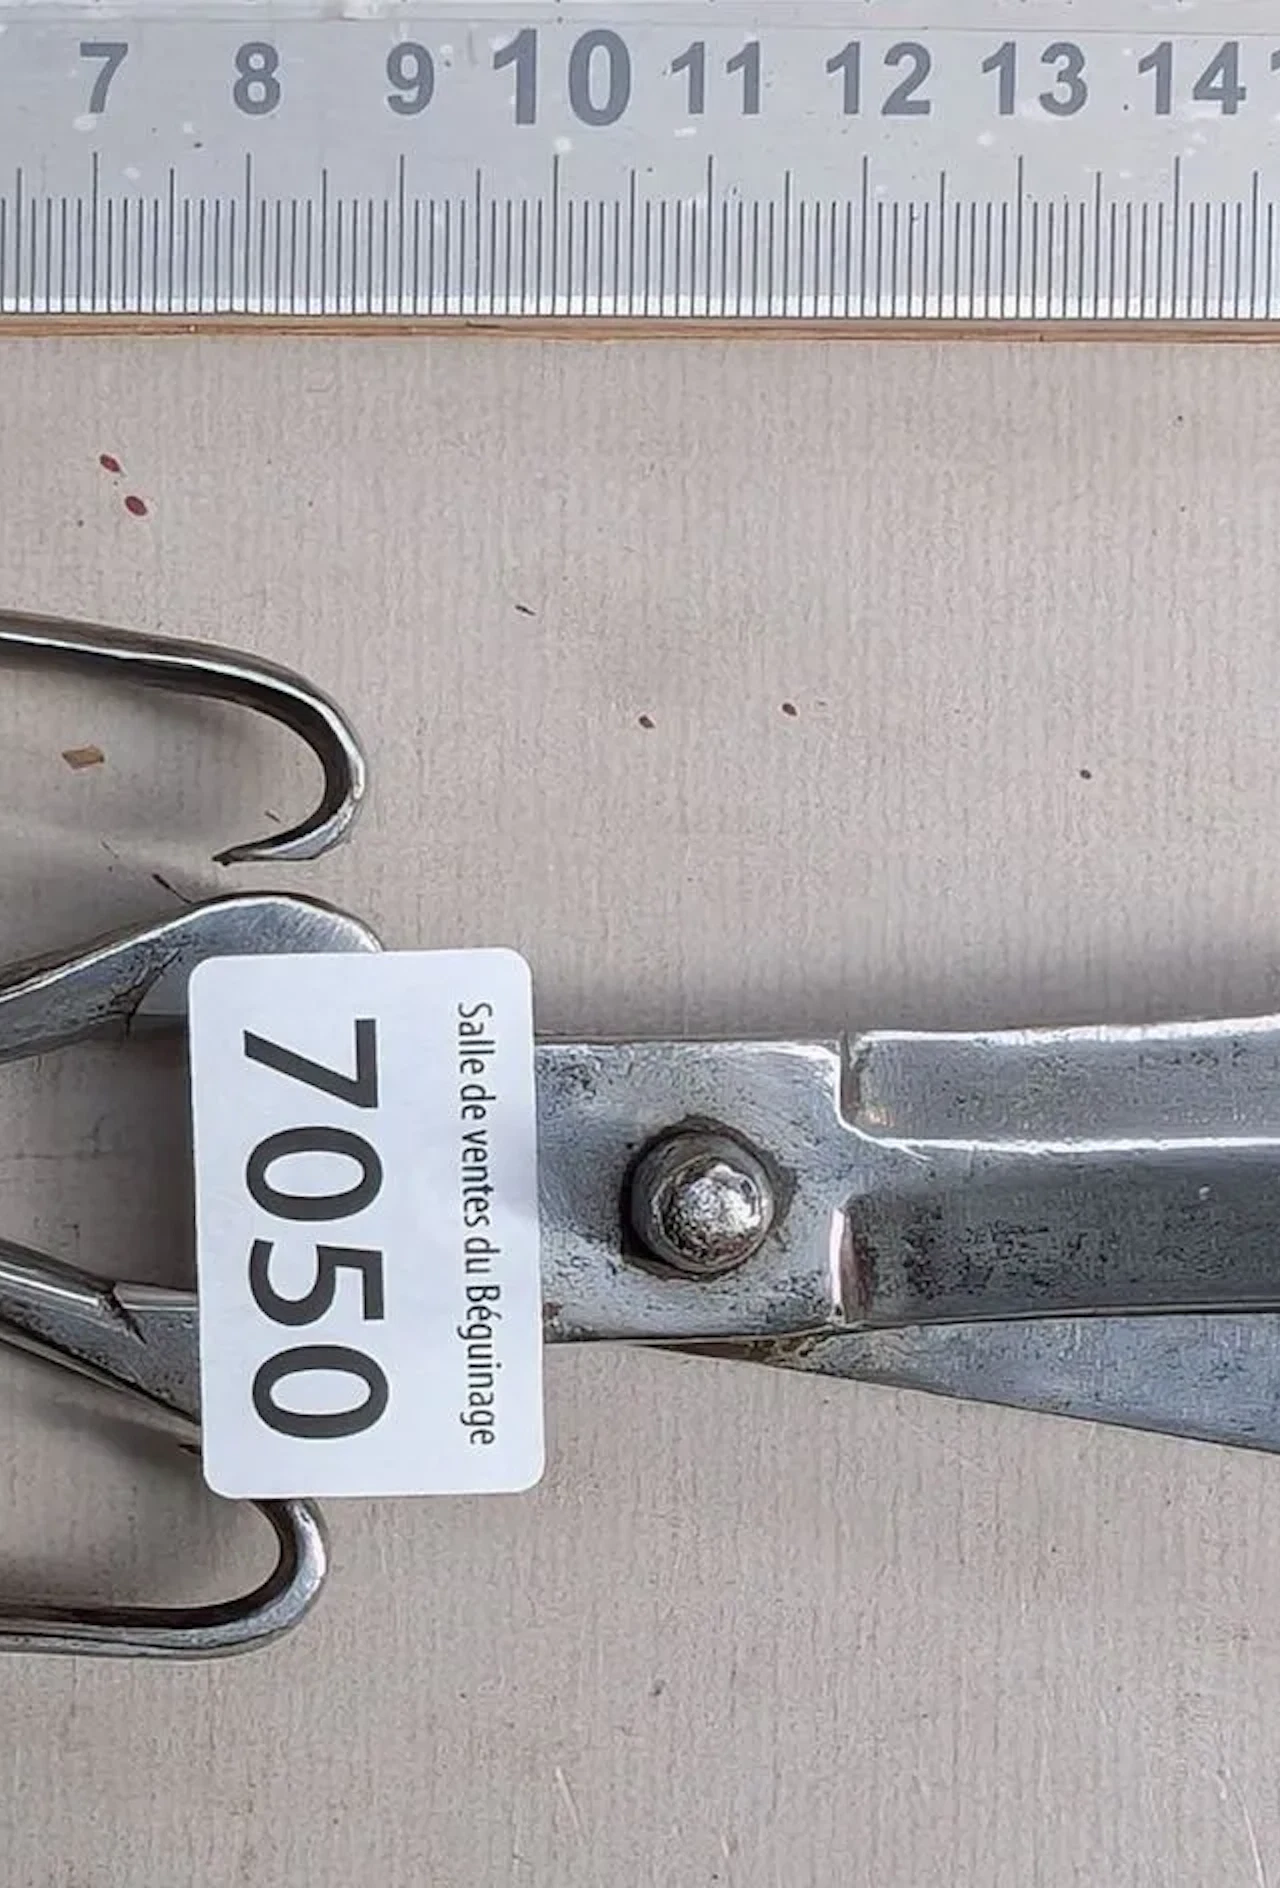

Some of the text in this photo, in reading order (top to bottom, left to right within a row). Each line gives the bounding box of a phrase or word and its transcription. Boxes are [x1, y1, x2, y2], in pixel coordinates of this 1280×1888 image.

[80, 42, 129, 113] 7
[233, 42, 281, 115] 8
[387, 42, 435, 115] 9
[493, 28, 632, 126] 10
[671, 41, 761, 115] 11
[826, 41, 932, 115] 12
[982, 41, 1088, 115] 13
[1138, 41, 1246, 115] 14
[243, 1018, 390, 1440] 7050
[457, 1002, 502, 1445] Salle de ventes du Béguinage
